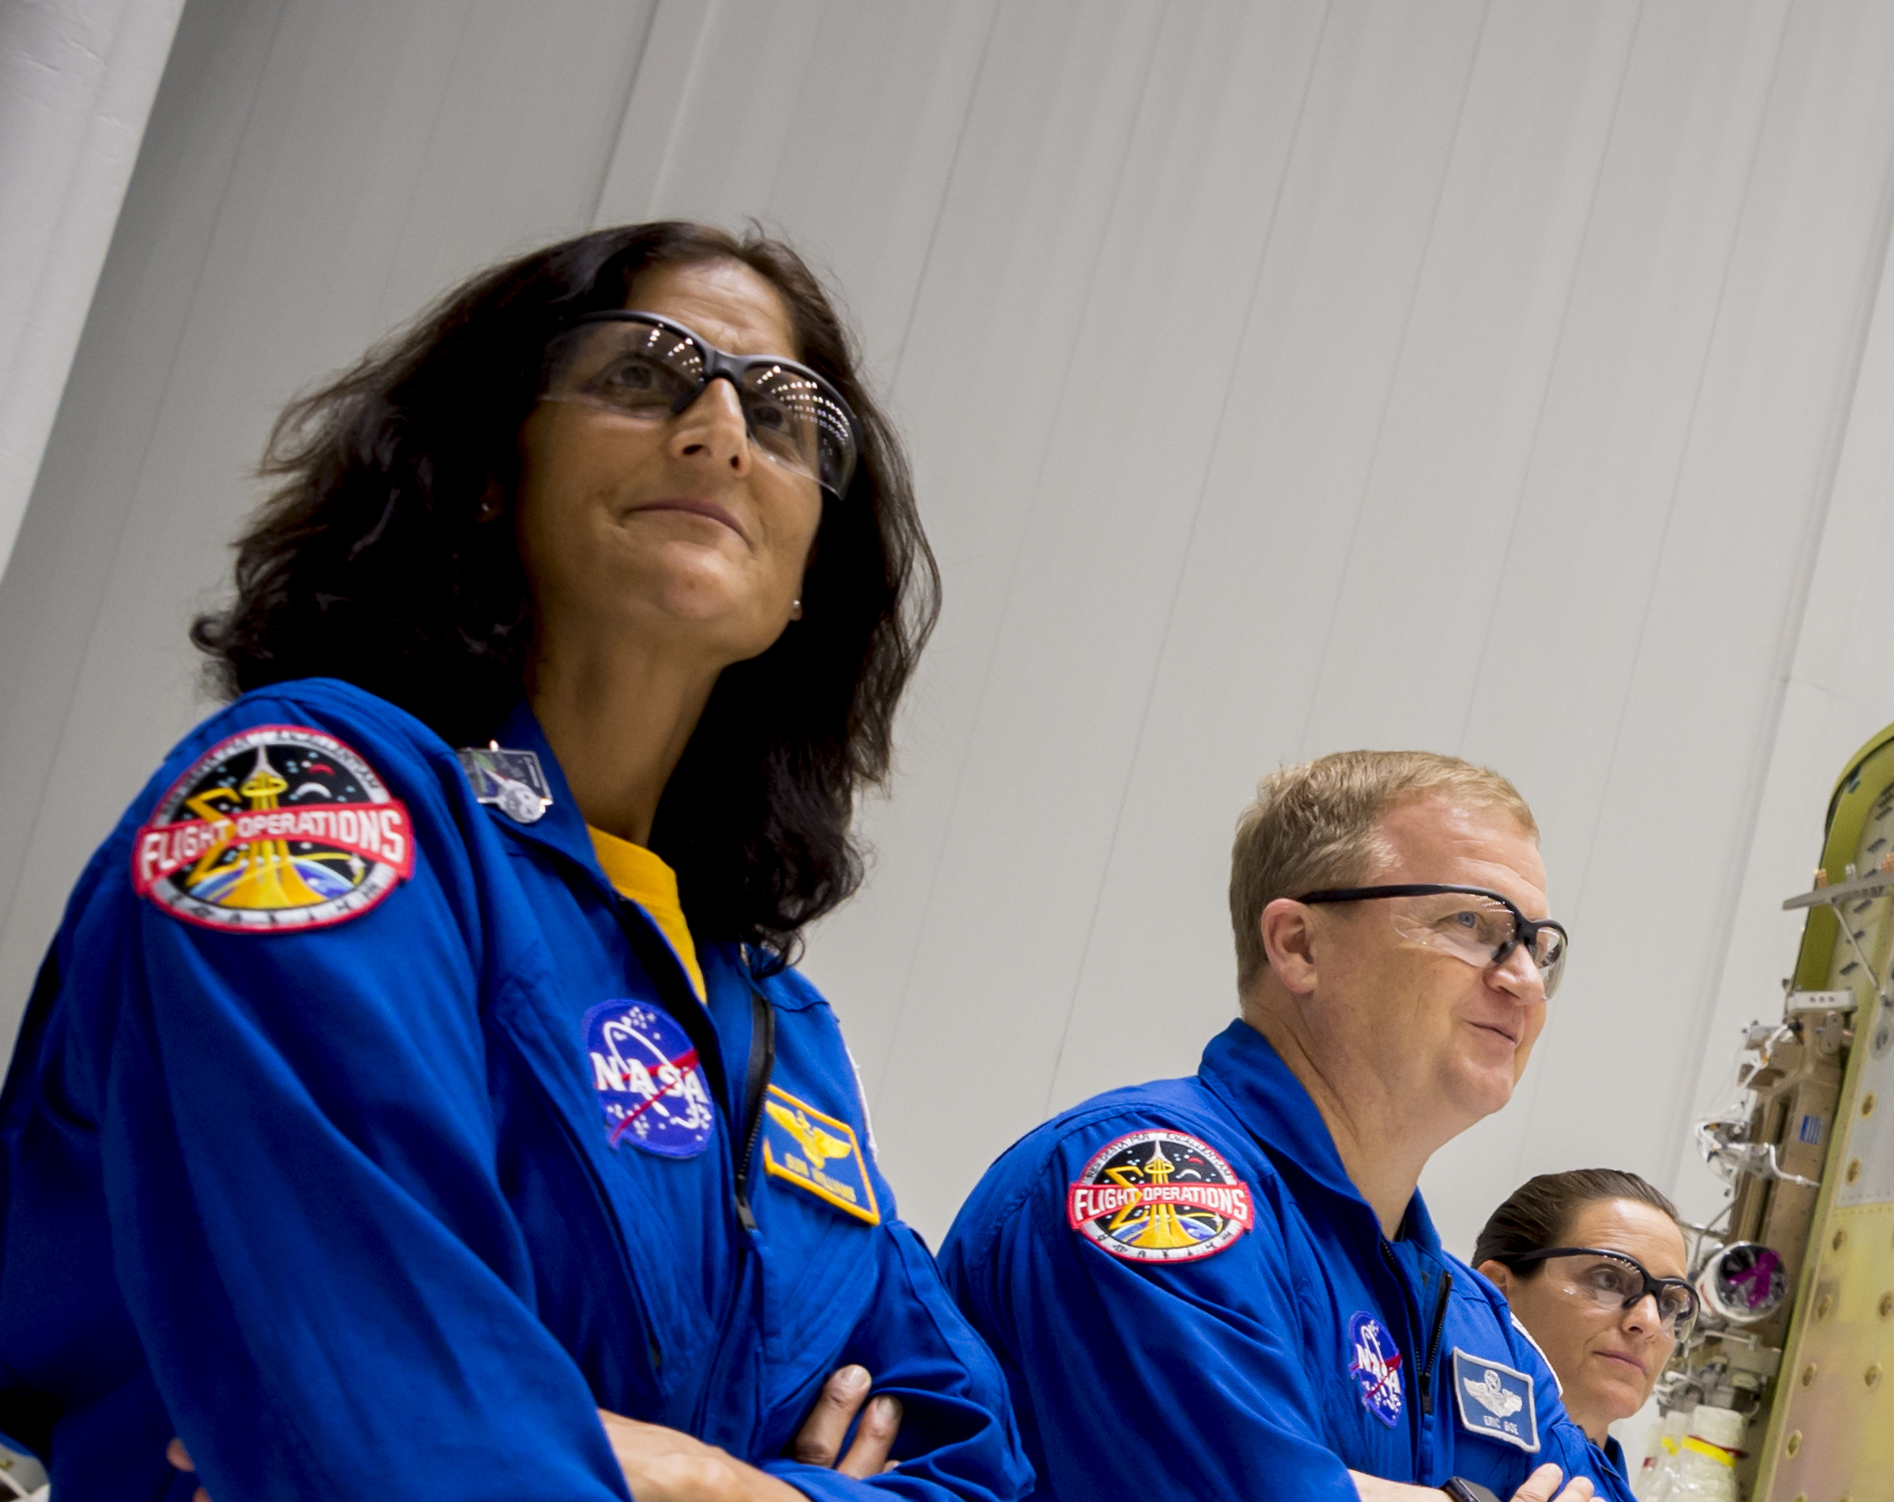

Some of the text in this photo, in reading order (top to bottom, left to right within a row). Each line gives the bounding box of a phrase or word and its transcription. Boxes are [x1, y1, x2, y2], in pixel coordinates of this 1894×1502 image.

[141, 809, 405, 881] FLIGHT OPERATIONS
[590, 1052, 710, 1104] NASA
[1074, 1187, 1248, 1221] FLIGHT OPERATIONS
[1356, 1343, 1400, 1394] NASA
